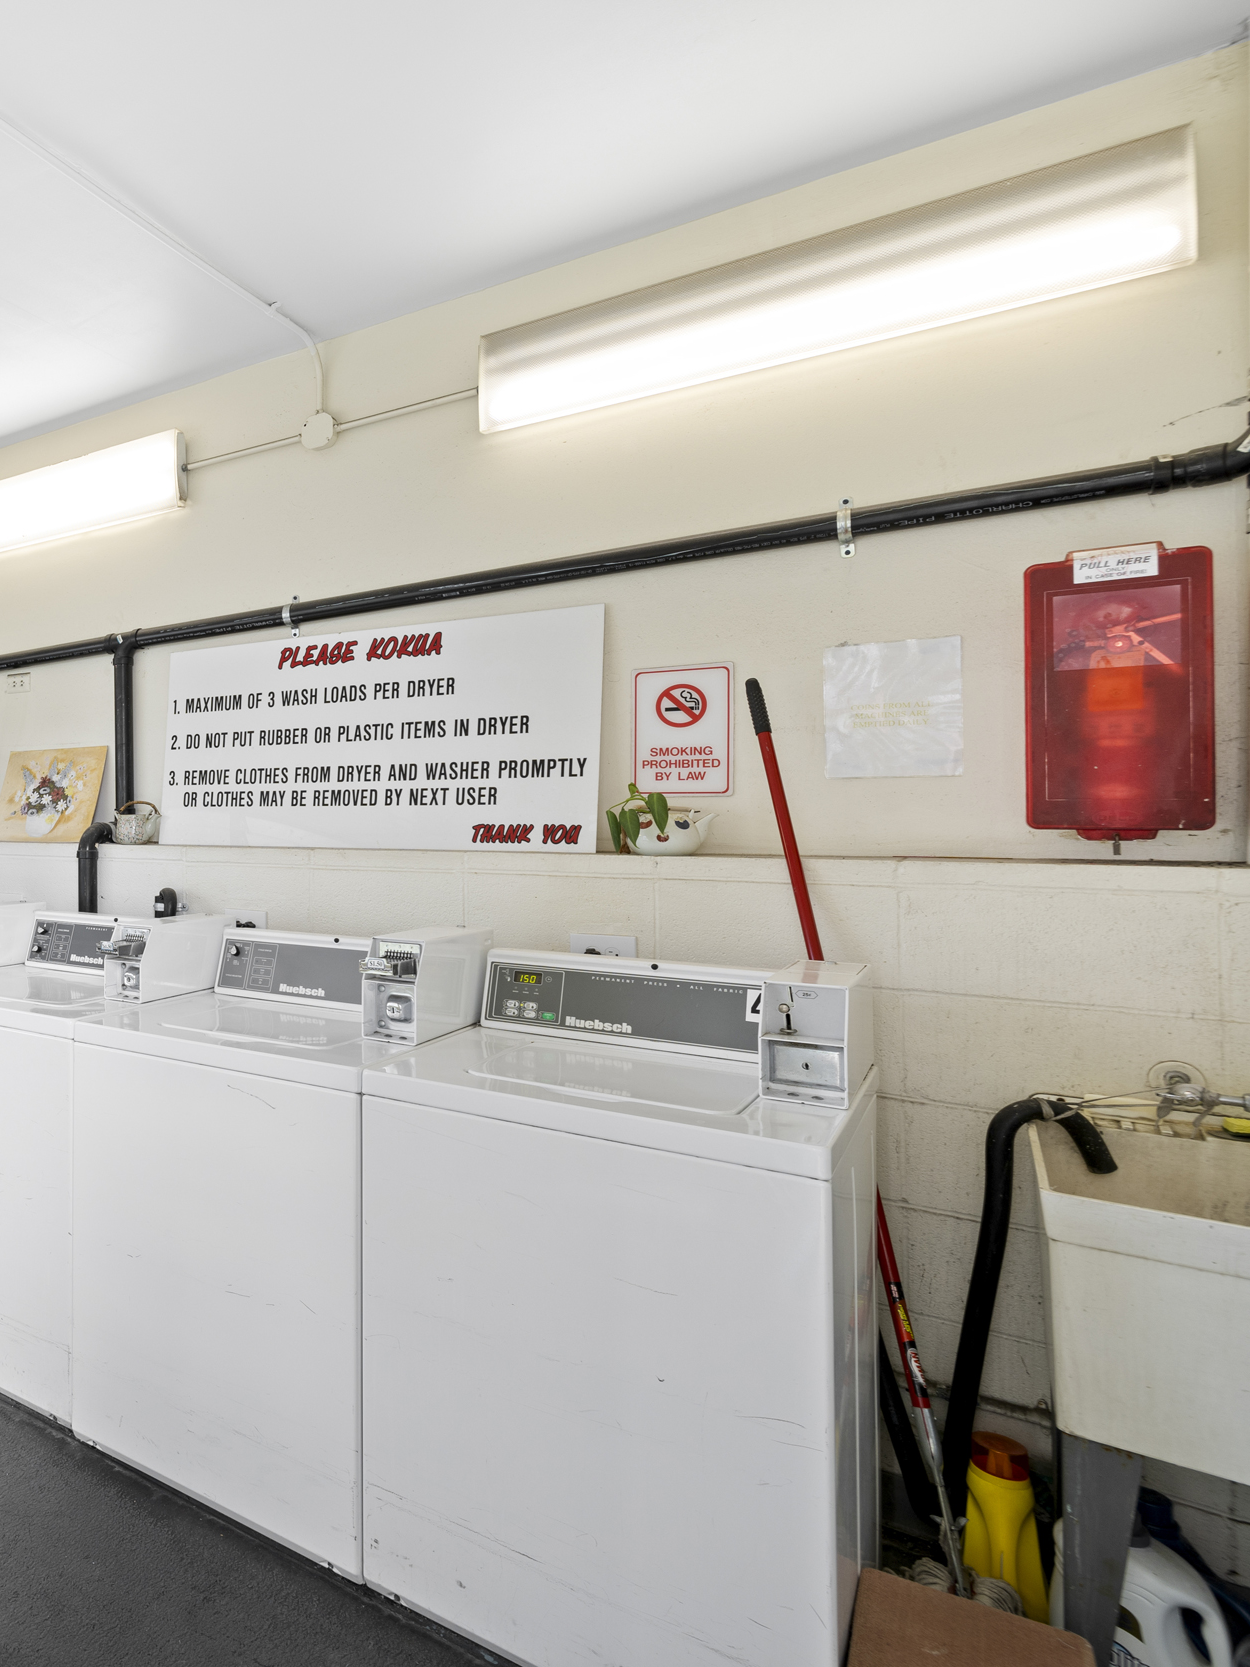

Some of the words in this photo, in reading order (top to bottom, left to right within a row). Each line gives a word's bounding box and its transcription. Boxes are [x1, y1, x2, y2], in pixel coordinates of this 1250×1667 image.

[944, 501, 1033, 520] CHARLOTTE
[1079, 560, 1110, 571] PULL
[1116, 555, 1151, 567] HERE
[234, 620, 273, 631] CHARLOTTE
[277, 640, 359, 670] PLEASE
[365, 631, 443, 662] KOKUA
[172, 698, 181, 716] 1.
[185, 694, 243, 714] MAXIMUM
[247, 692, 263, 710] OF
[267, 691, 275, 708] 3
[281, 687, 318, 707] WASH
[323, 683, 367, 704] LOADS
[373, 681, 400, 701] PER
[407, 677, 455, 698] DRYER
[850, 704, 881, 712] COINS
[883, 702, 911, 710] FROM
[913, 700, 933, 708] ALL
[855, 711, 907, 720] MACHINES
[910, 709, 930, 717] ARE
[853, 720, 895, 729] EMPTIED
[170, 734, 181, 751] 2.
[185, 733, 201, 750] DO
[205, 732, 229, 749] NOT
[232, 730, 255, 748] PUT
[259, 727, 308, 746] RUBBER
[314, 726, 331, 744] OR
[337, 722, 394, 743] PLASTIC
[400, 719, 447, 740] ITEMS
[453, 718, 470, 737] IN
[477, 714, 530, 736] DRYER
[650, 746, 713, 757] SMOKING
[642, 758, 721, 769] PROHIBITED
[168, 770, 179, 786] 3.
[183, 769, 230, 786] REMOVE
[235, 767, 289, 785] CLOTHES
[294, 765, 331, 784] FROM
[337, 764, 382, 783] DRYER
[387, 763, 418, 782] AND
[425, 760, 490, 781] WASHER
[498, 757, 588, 779] PROMPTLY
[655, 771, 672, 781] BY
[678, 771, 706, 781] LAW
[183, 791, 198, 808] OR
[202, 790, 254, 808] CLOTHES
[259, 790, 286, 807] MAY
[290, 790, 307, 807] BE
[312, 788, 378, 807] REMOVED
[384, 788, 403, 806] BY
[408, 787, 450, 806] NEXT
[455, 786, 498, 806] USER
[471, 823, 535, 845] THANK
[541, 823, 583, 845] YOU
[70, 953, 103, 965] Huebsch
[519, 974, 537, 984] 150
[592, 976, 634, 984] PERMANENT
[279, 983, 325, 997] Huebsch
[565, 1015, 632, 1034] Huebsch
